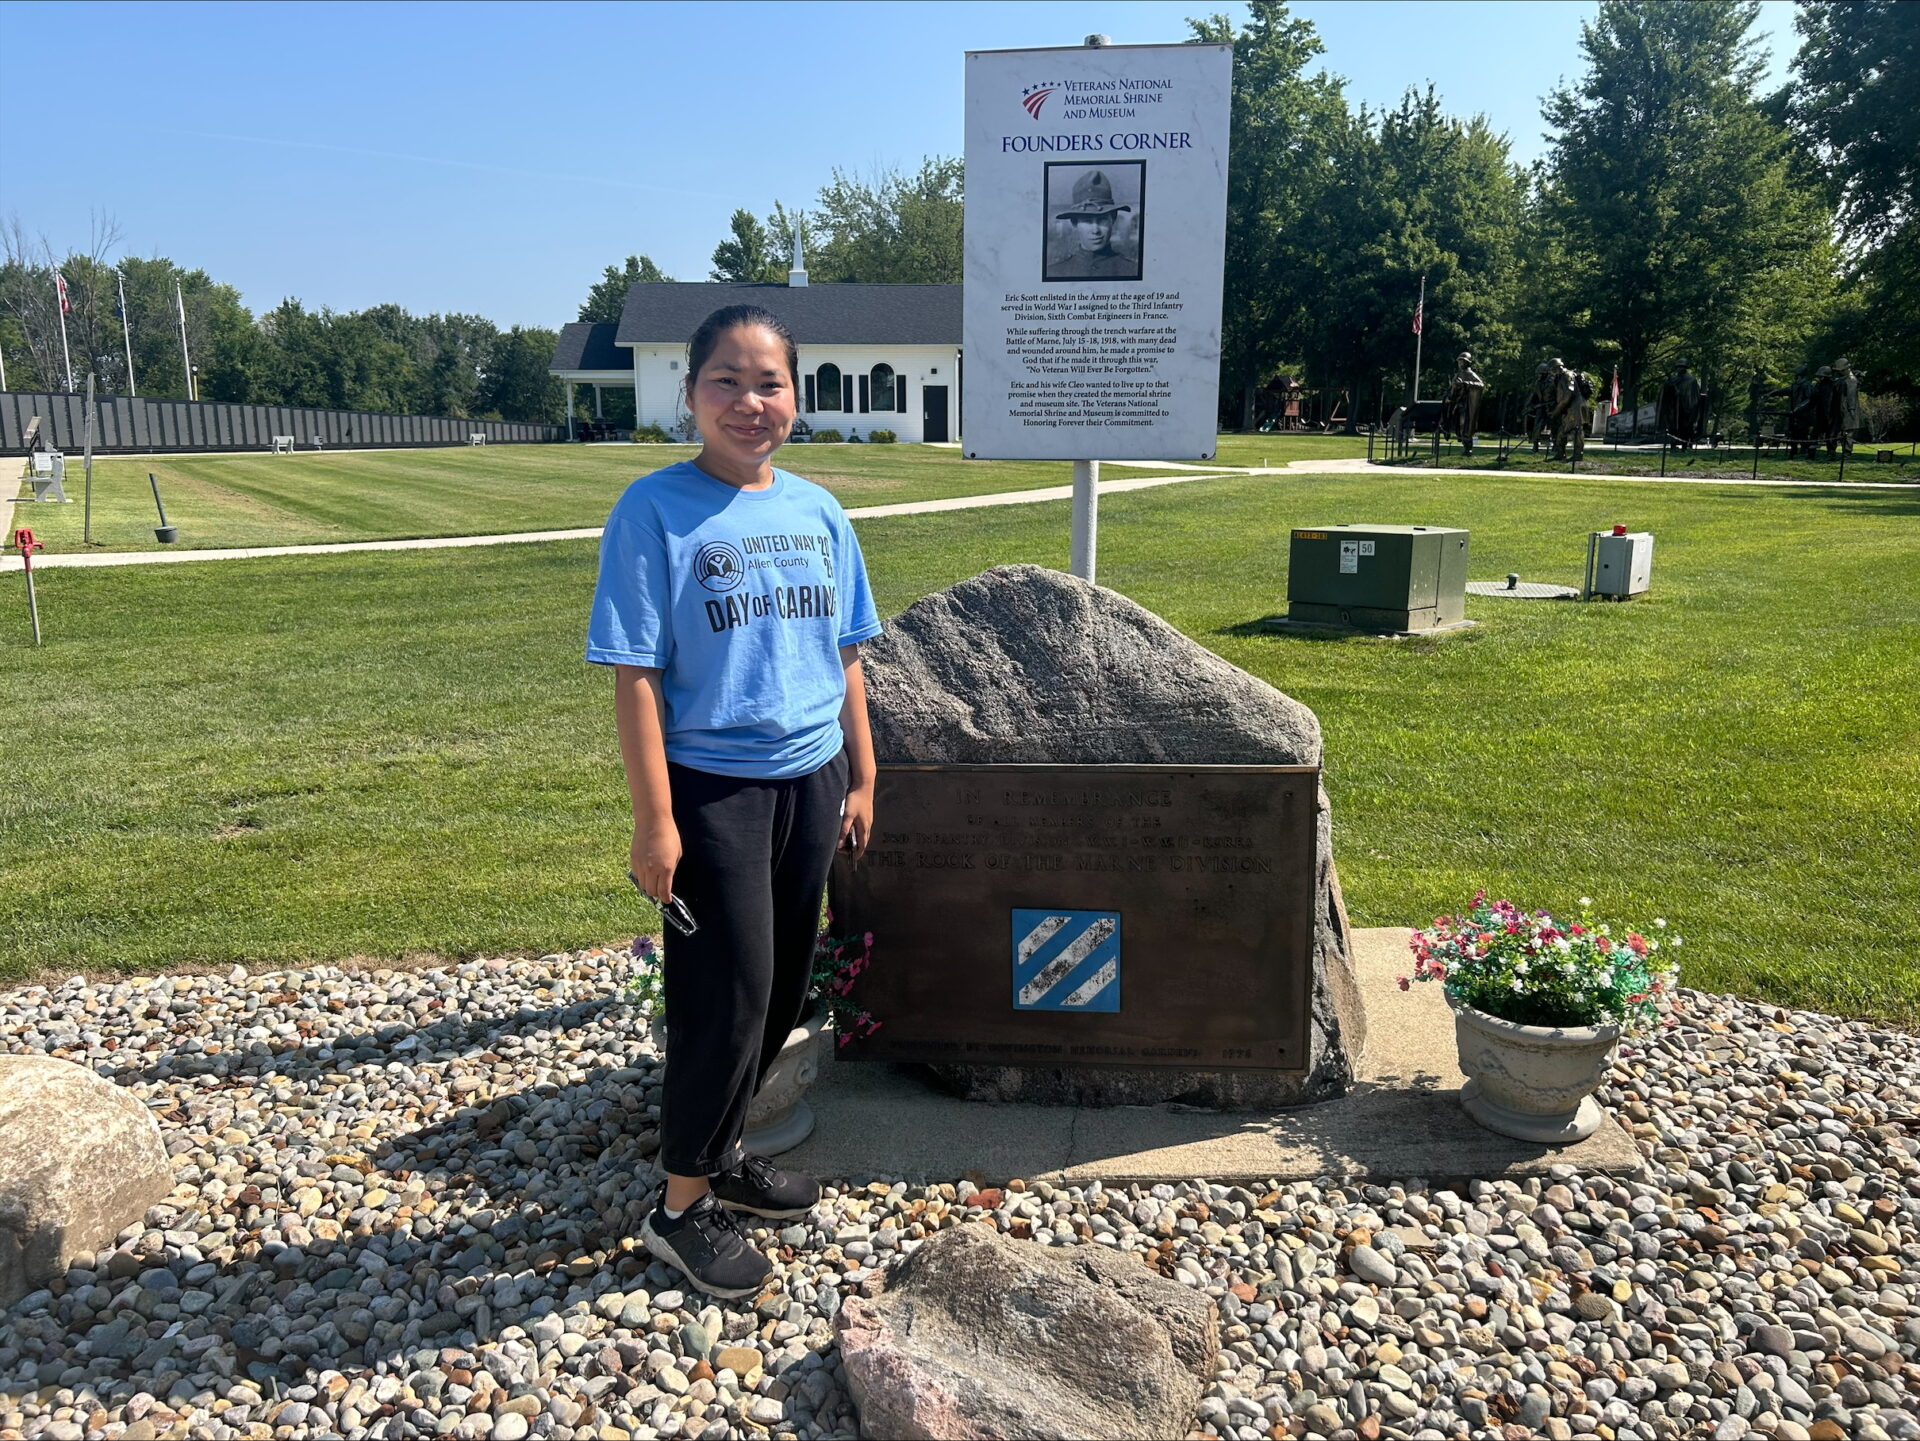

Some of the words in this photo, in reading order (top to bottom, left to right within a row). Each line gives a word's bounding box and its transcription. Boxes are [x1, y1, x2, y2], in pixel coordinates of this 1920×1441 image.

[1002, 134, 1103, 152] FOUNDERS
[1110, 132, 1192, 150] CORNER
[1090, 293, 1110, 302] Army
[1079, 303, 1108, 312] assigned
[1154, 302, 1183, 311] Infantry
[1015, 313, 1046, 321] Division,
[1098, 313, 1132, 321] Engineers
[1029, 328, 1059, 337] suffering
[1061, 328, 1090, 336] through
[1062, 338, 1076, 346] July
[1082, 347, 1099, 355] him,
[1099, 357, 1127, 365] through
[1023, 419, 1056, 427] Honoring
[742, 535, 789, 554] UNITED
[790, 534, 816, 552] WAY
[1362, 544, 1372, 553] 50
[748, 559, 772, 570] Allen
[774, 557, 809, 568] County
[704, 592, 750, 633] DAY
[752, 594, 771, 618] OF
[955, 789, 981, 805] IN
[1003, 790, 1172, 808] REMEMBRANCE
[867, 851, 905, 868] THE
[916, 853, 975, 870] ROCK
[985, 854, 1010, 870] OF
[1024, 855, 1063, 871] THE
[1076, 856, 1157, 872] MARNE
[1170, 856, 1272, 874] DIVISION
